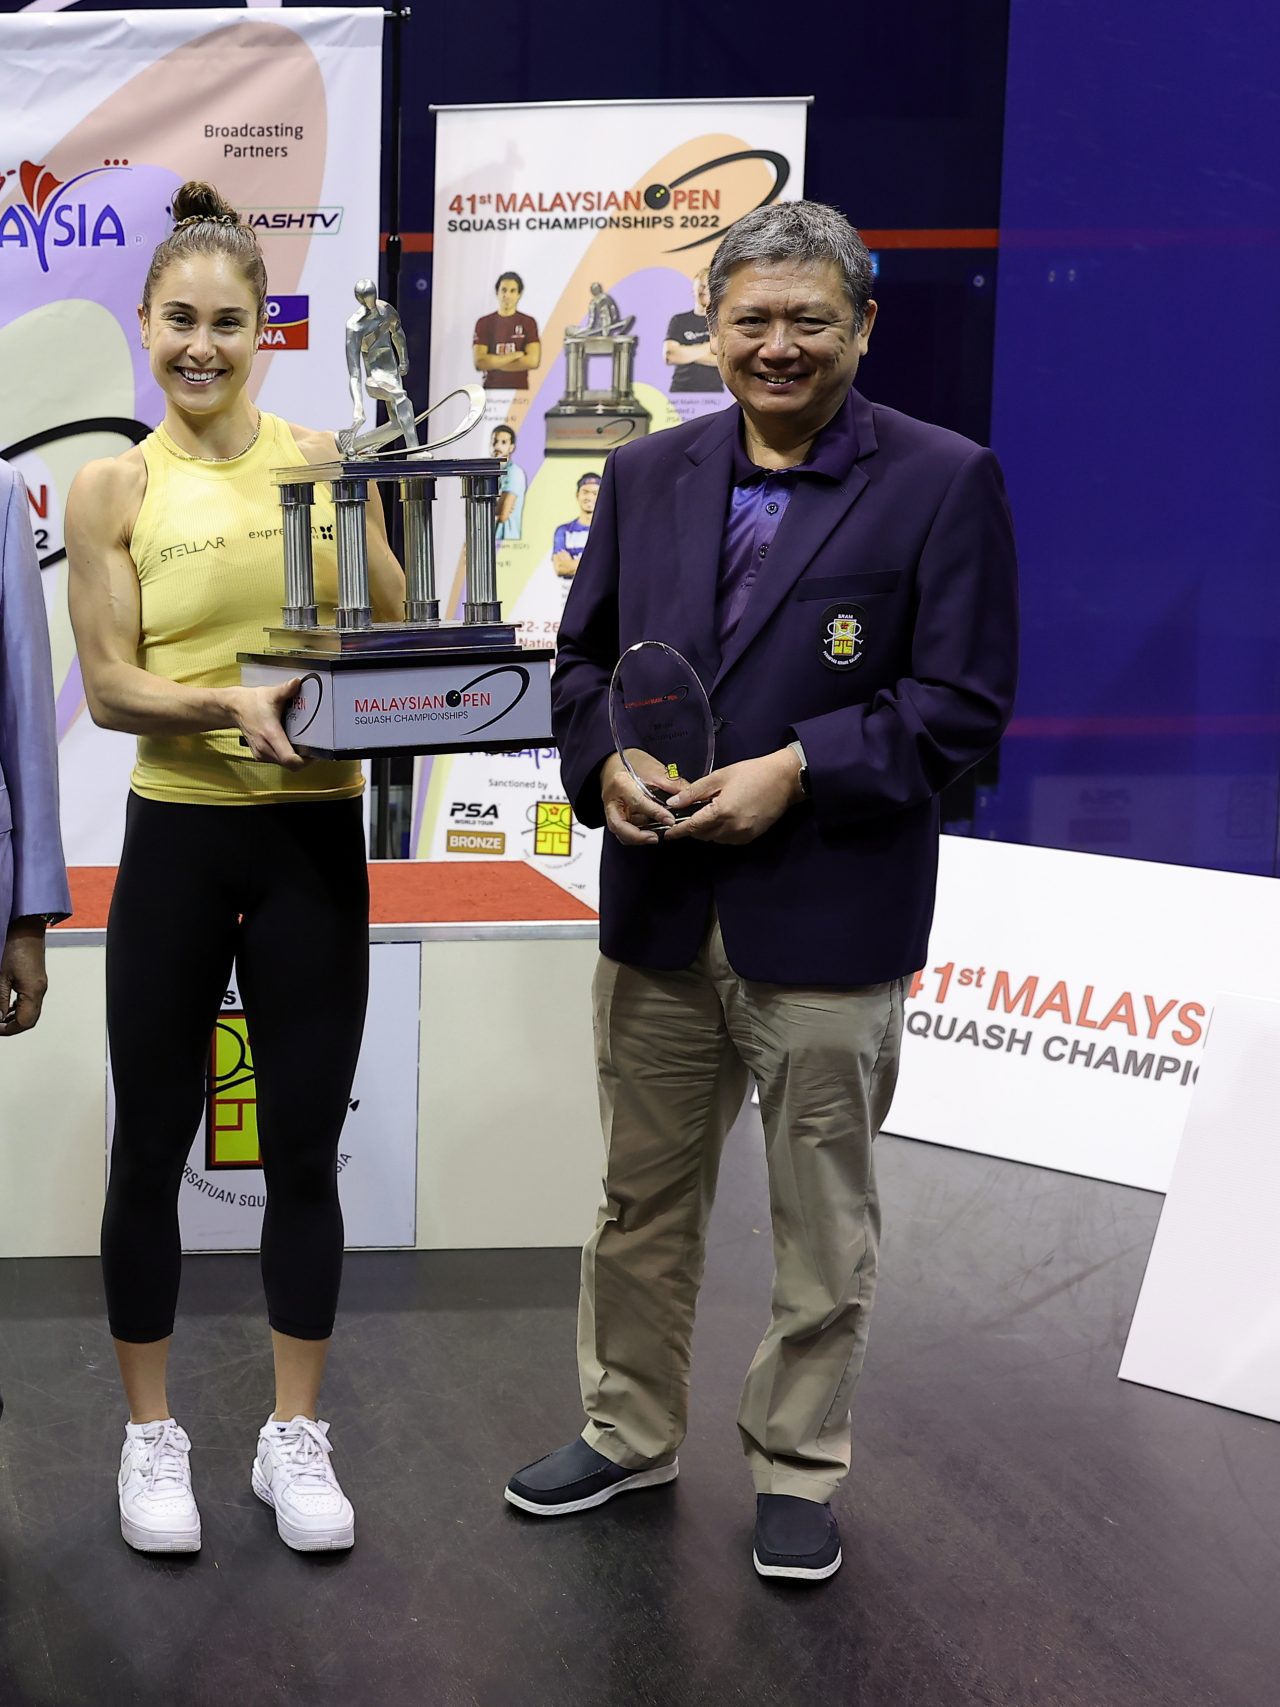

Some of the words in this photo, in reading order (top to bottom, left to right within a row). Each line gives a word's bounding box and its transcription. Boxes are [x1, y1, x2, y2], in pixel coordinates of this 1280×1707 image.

[204, 123, 304, 140] Broadcasting
[223, 144, 288, 158] Partners
[449, 193, 492, 216] 41st
[447, 217, 520, 232] SQUASH
[526, 216, 674, 230] CHAMPIONSHIPS
[679, 215, 720, 229] 2022
[160, 536, 226, 562] STELLAR
[518, 637, 557, 648] Natio
[354, 713, 393, 725] SQUASH
[394, 710, 469, 723] CHAMPIONSHIPS
[488, 778, 536, 789] Sanctioned
[538, 779, 548, 790] by
[450, 802, 499, 819] PSA
[454, 818, 476, 826] WORLD
[449, 835, 502, 850] BRONZE
[987, 970, 1206, 1046] MALAYS
[905, 1009, 1033, 1057] QUASH
[1042, 1035, 1200, 1087] CHAMPI
